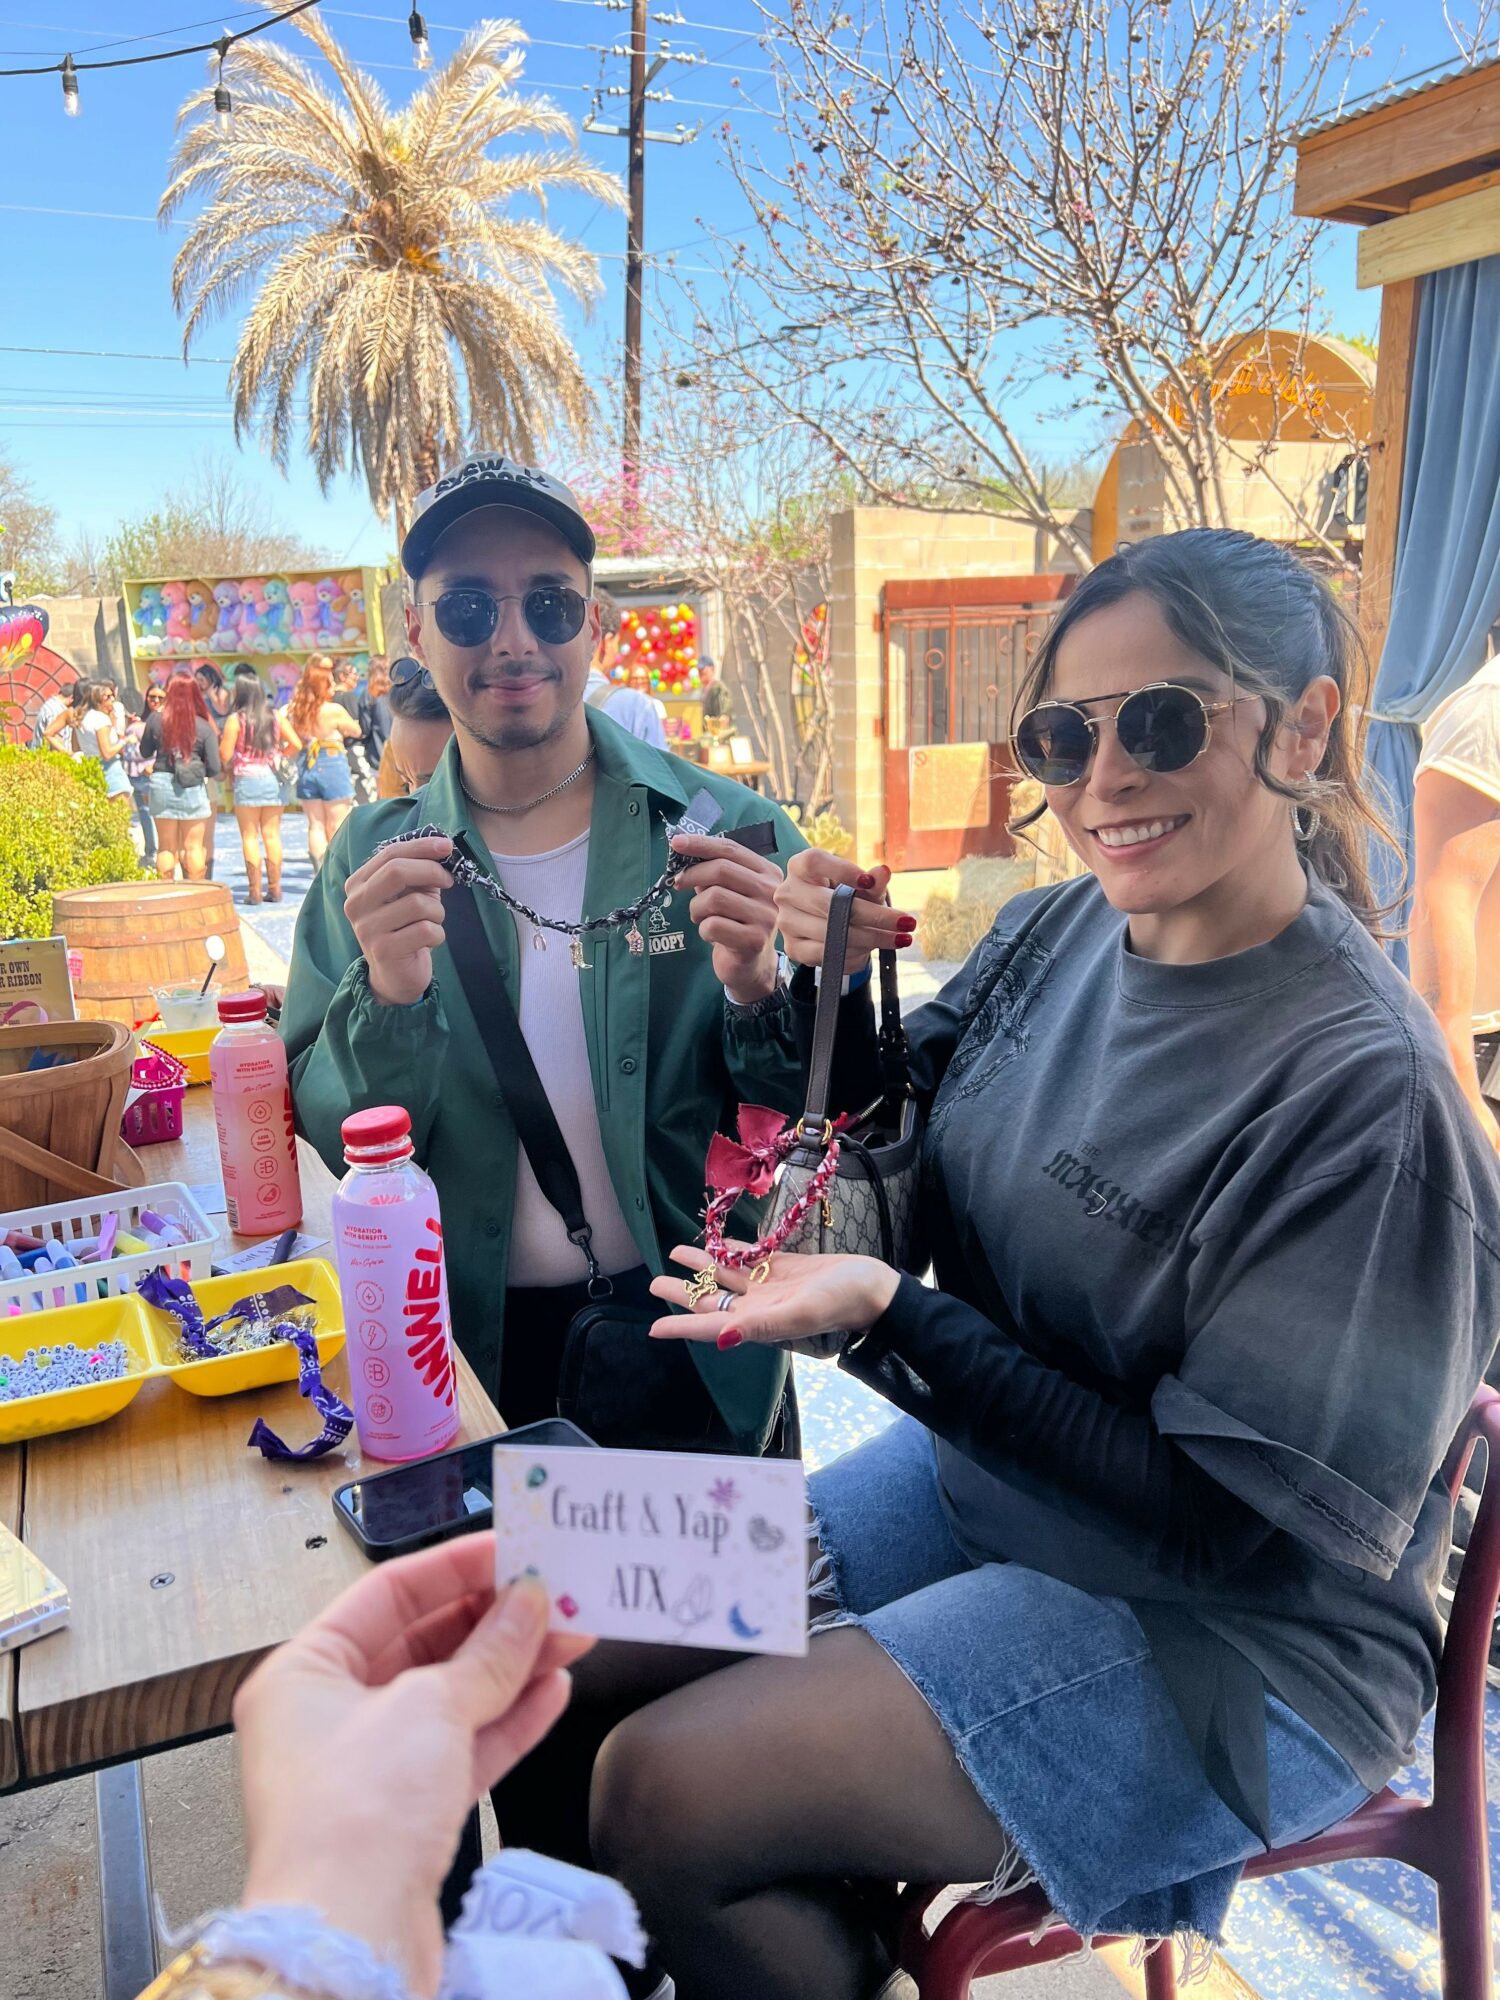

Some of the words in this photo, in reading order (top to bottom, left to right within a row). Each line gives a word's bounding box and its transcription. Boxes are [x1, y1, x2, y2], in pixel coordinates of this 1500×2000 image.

[9, 961, 30, 973] OWN
[7, 973, 42, 987] RIBBON
[1079, 1138, 1102, 1160] THE
[344, 1231, 357, 1239] WITH
[346, 1225, 383, 1234] HYDRATION
[551, 1484, 628, 1534] Craft
[641, 1491, 662, 1536] &
[673, 1493, 730, 1555] Yap
[608, 1562, 667, 1615] ATX
